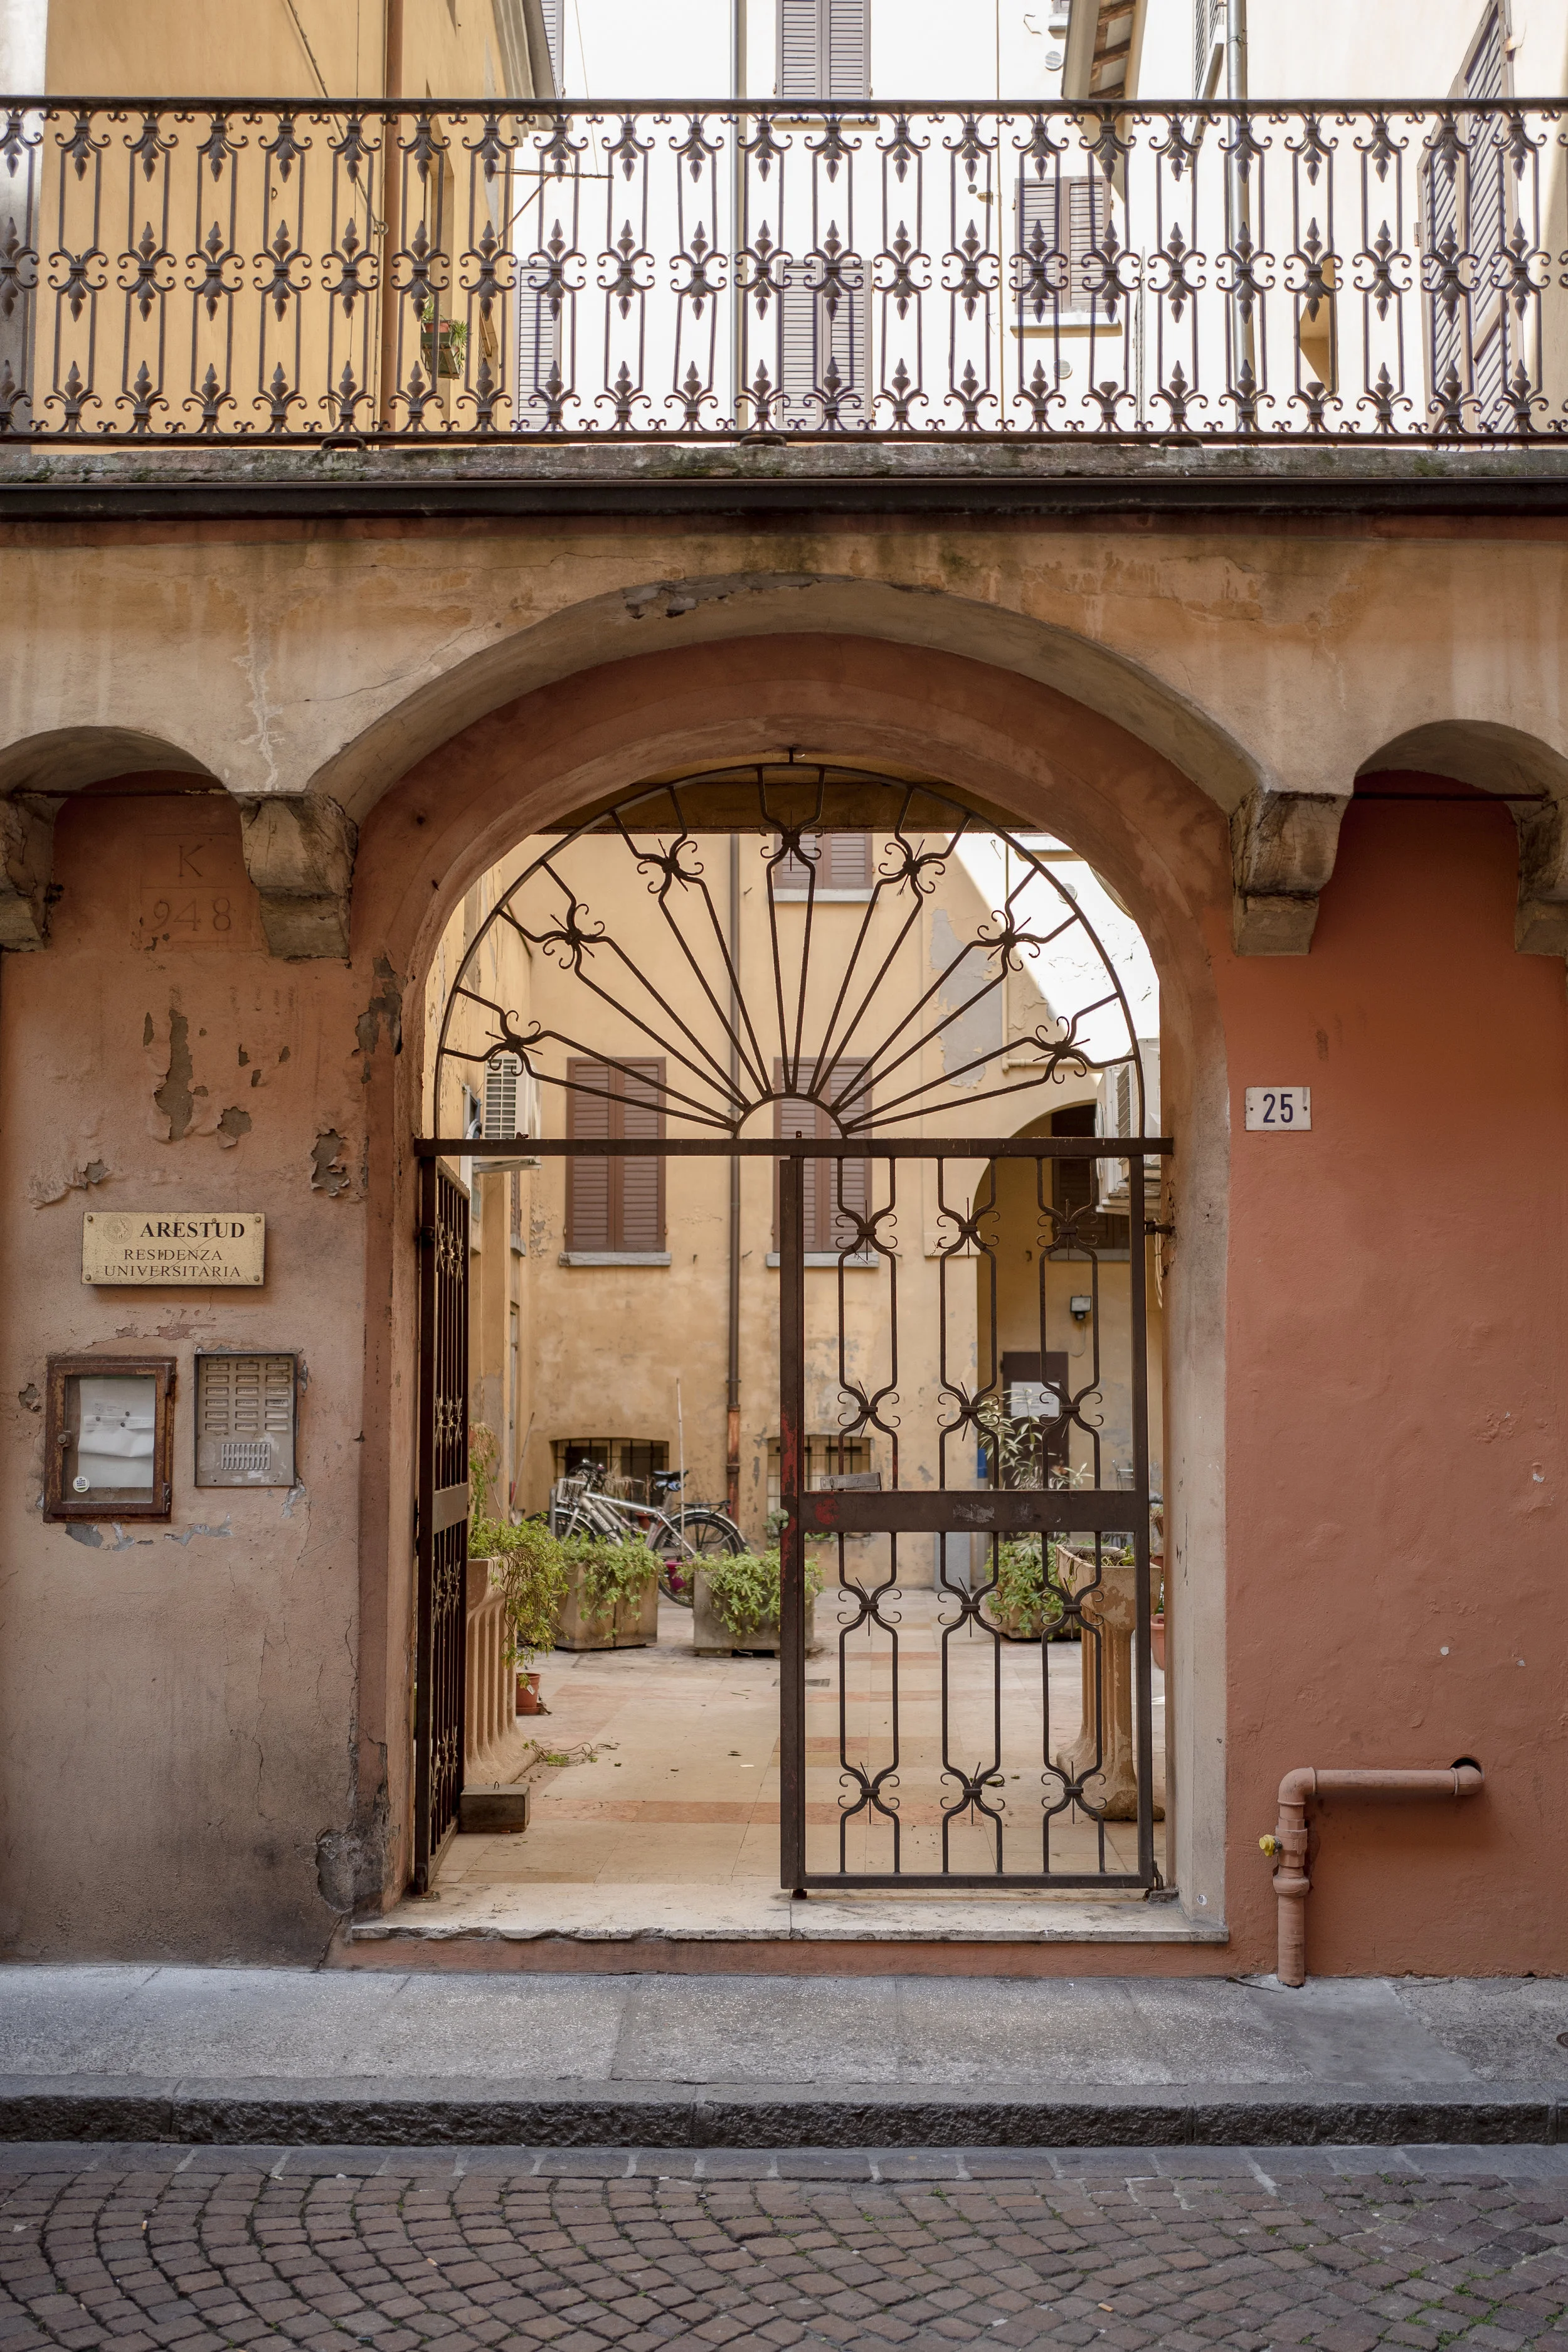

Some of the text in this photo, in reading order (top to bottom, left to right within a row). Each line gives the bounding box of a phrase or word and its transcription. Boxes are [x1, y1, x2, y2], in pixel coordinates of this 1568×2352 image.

[179, 845, 204, 877] K
[1263, 1093, 1293, 1123] 25
[139, 1222, 245, 1238] ARESTUD
[124, 1249, 223, 1261] RESIDENZA
[105, 1265, 241, 1277] UNIVERSITARIA
